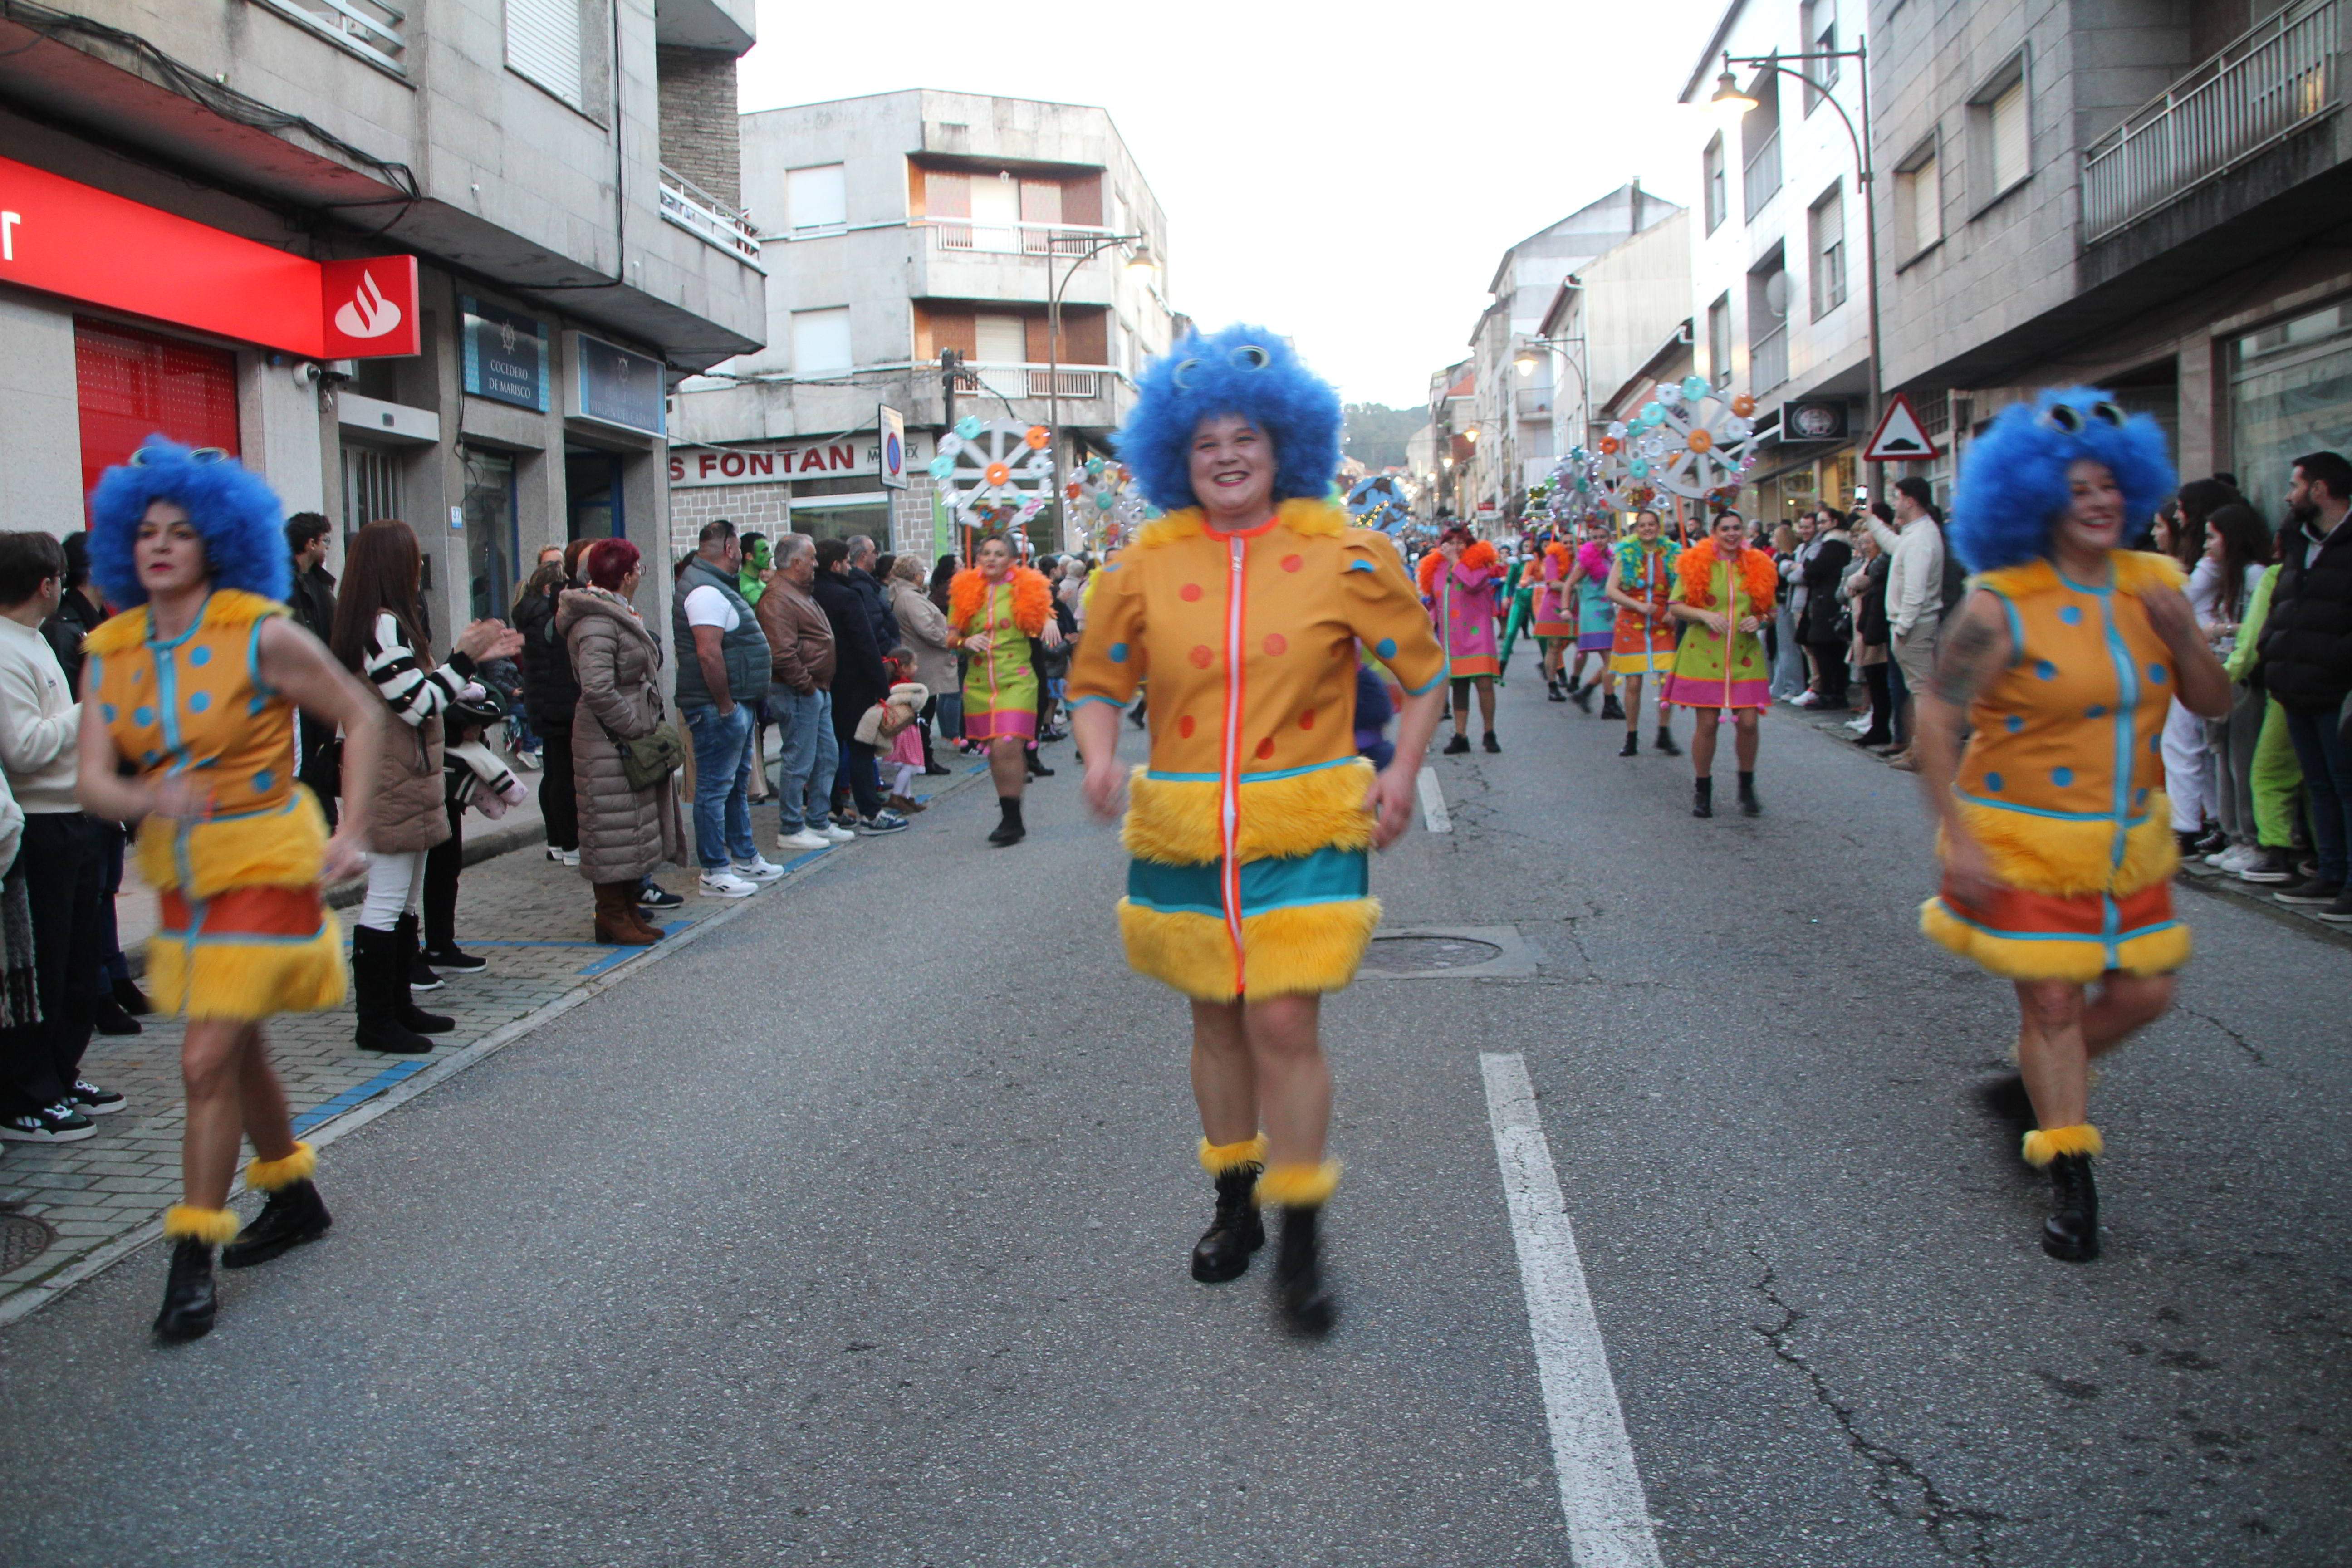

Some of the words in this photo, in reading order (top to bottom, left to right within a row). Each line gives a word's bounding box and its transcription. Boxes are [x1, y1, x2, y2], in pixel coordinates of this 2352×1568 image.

[490, 359, 528, 380] COCEDERO
[490, 377, 497, 390] DE
[500, 381, 530, 399] MARISCO
[699, 444, 854, 478] FONTAN
[453, 508, 460, 518] 37
